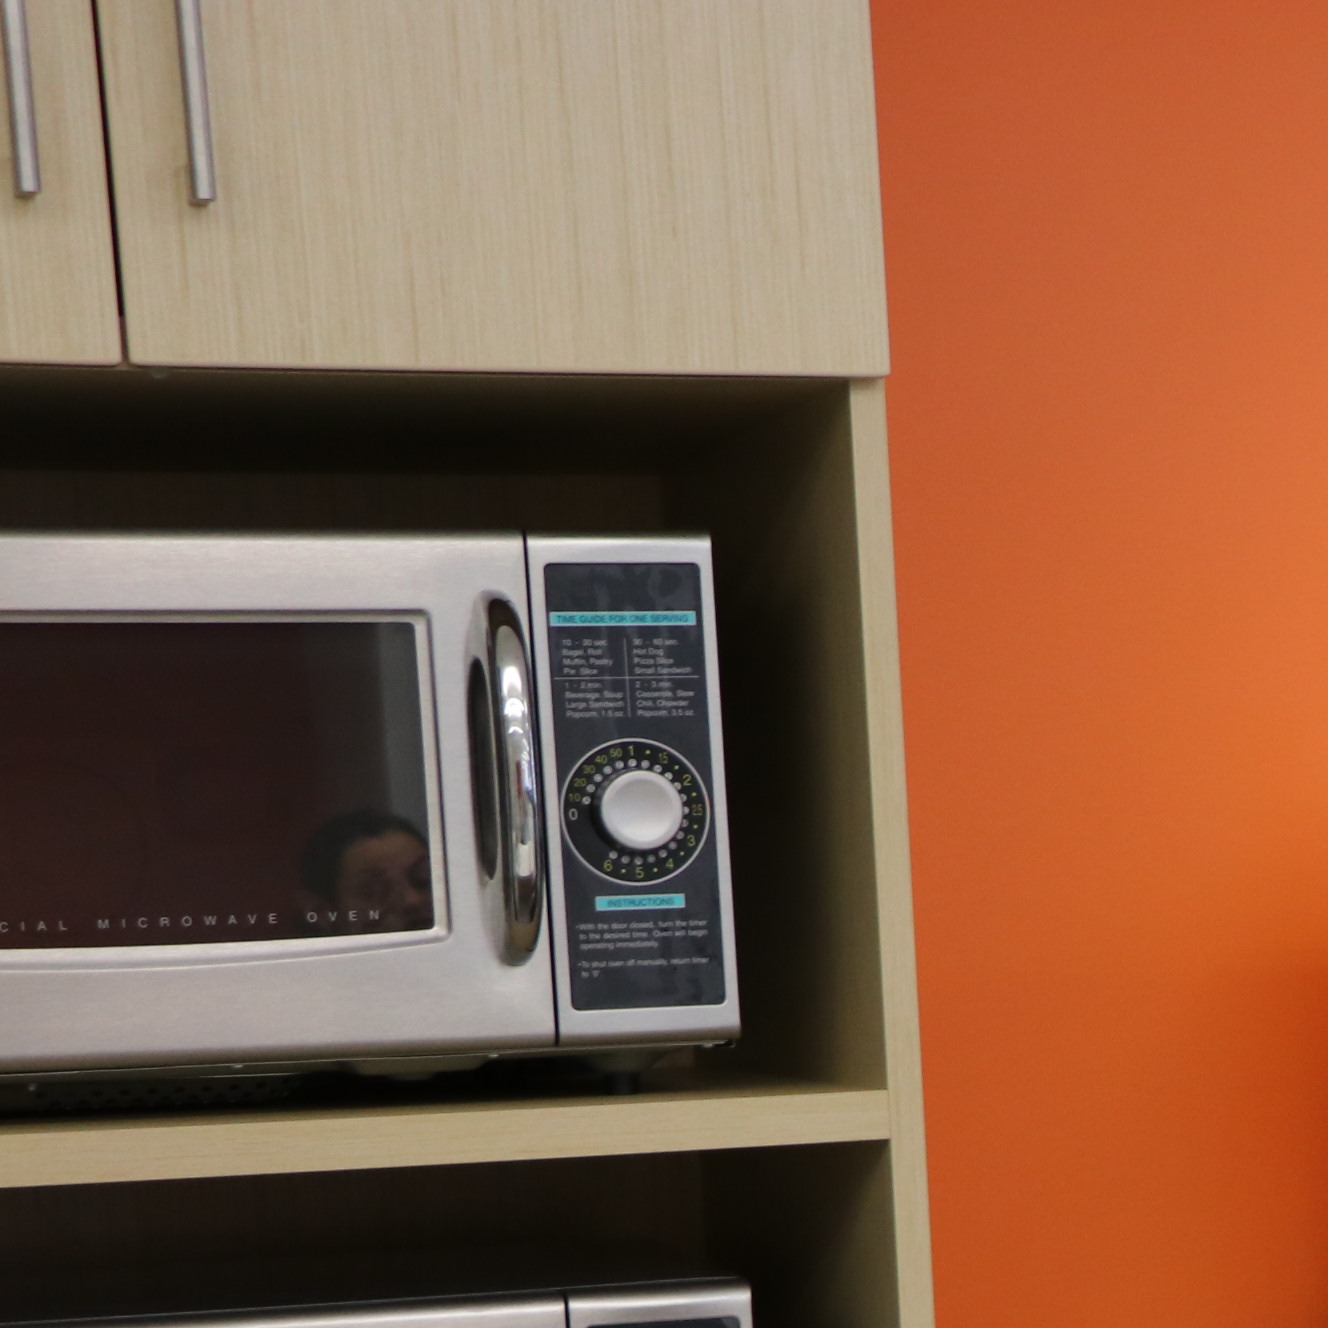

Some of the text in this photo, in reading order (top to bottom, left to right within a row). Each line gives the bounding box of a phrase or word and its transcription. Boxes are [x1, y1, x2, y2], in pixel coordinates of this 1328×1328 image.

[557, 613, 688, 623] TIME GUIDE FOR ONE SERVING
[610, 748, 623, 758] 50
[628, 745, 634, 755] 1
[595, 754, 608, 764] 40
[584, 765, 596, 774] 30
[574, 778, 587, 787] 20
[683, 775, 692, 786] 2
[569, 793, 581, 802] 10
[569, 809, 578, 820] 0
[687, 835, 696, 846] 3
[603, 860, 613, 871] 6
[665, 858, 674, 868] 4
[635, 867, 644, 878] 5
[607, 897, 674, 908] INSTRUCTIONS
[98, 913, 279, 929] MICROWAVE
[306, 909, 381, 923] OVEN
